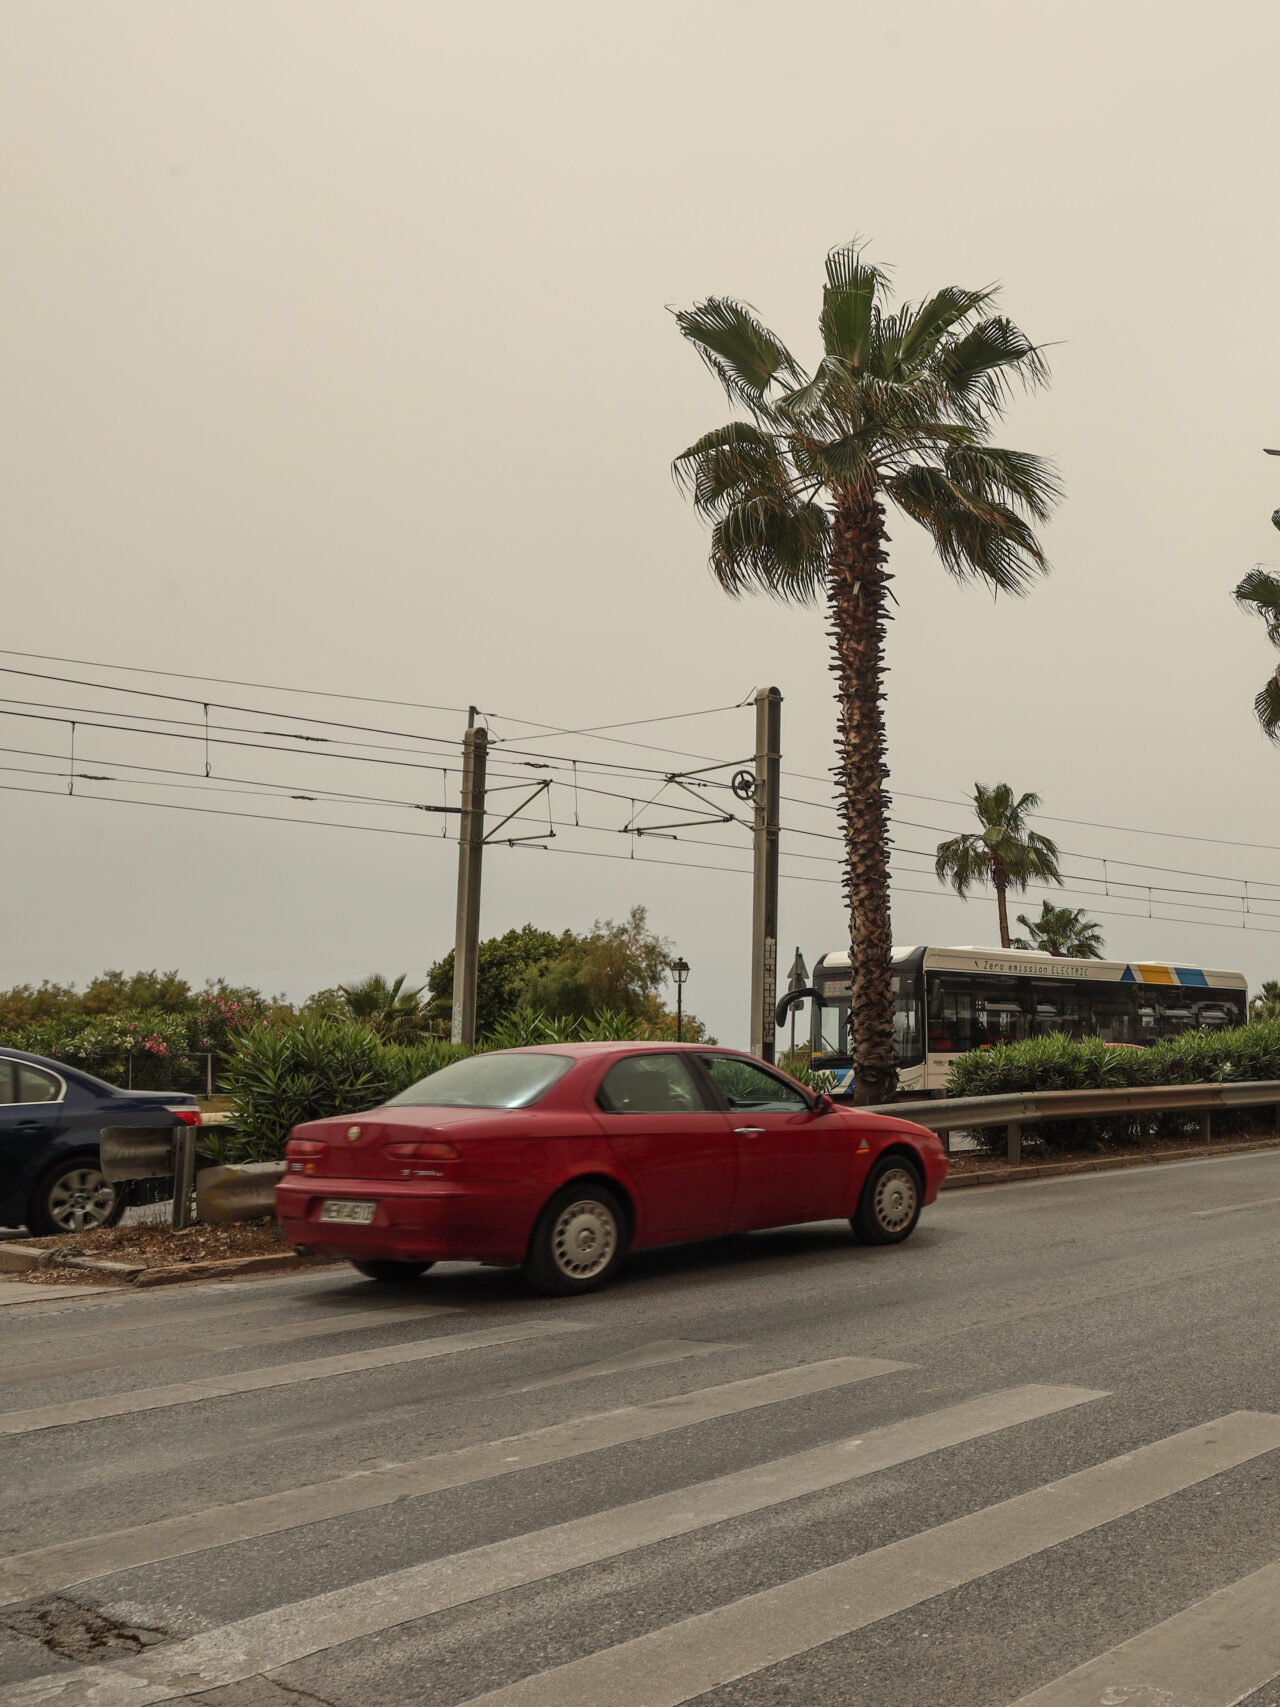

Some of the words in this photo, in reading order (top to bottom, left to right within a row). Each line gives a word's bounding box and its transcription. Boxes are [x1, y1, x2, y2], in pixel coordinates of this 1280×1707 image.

[983, 960, 1005, 971] Zero
[1008, 963, 1048, 974] emission
[1051, 965, 1089, 977] ELECTRIC
